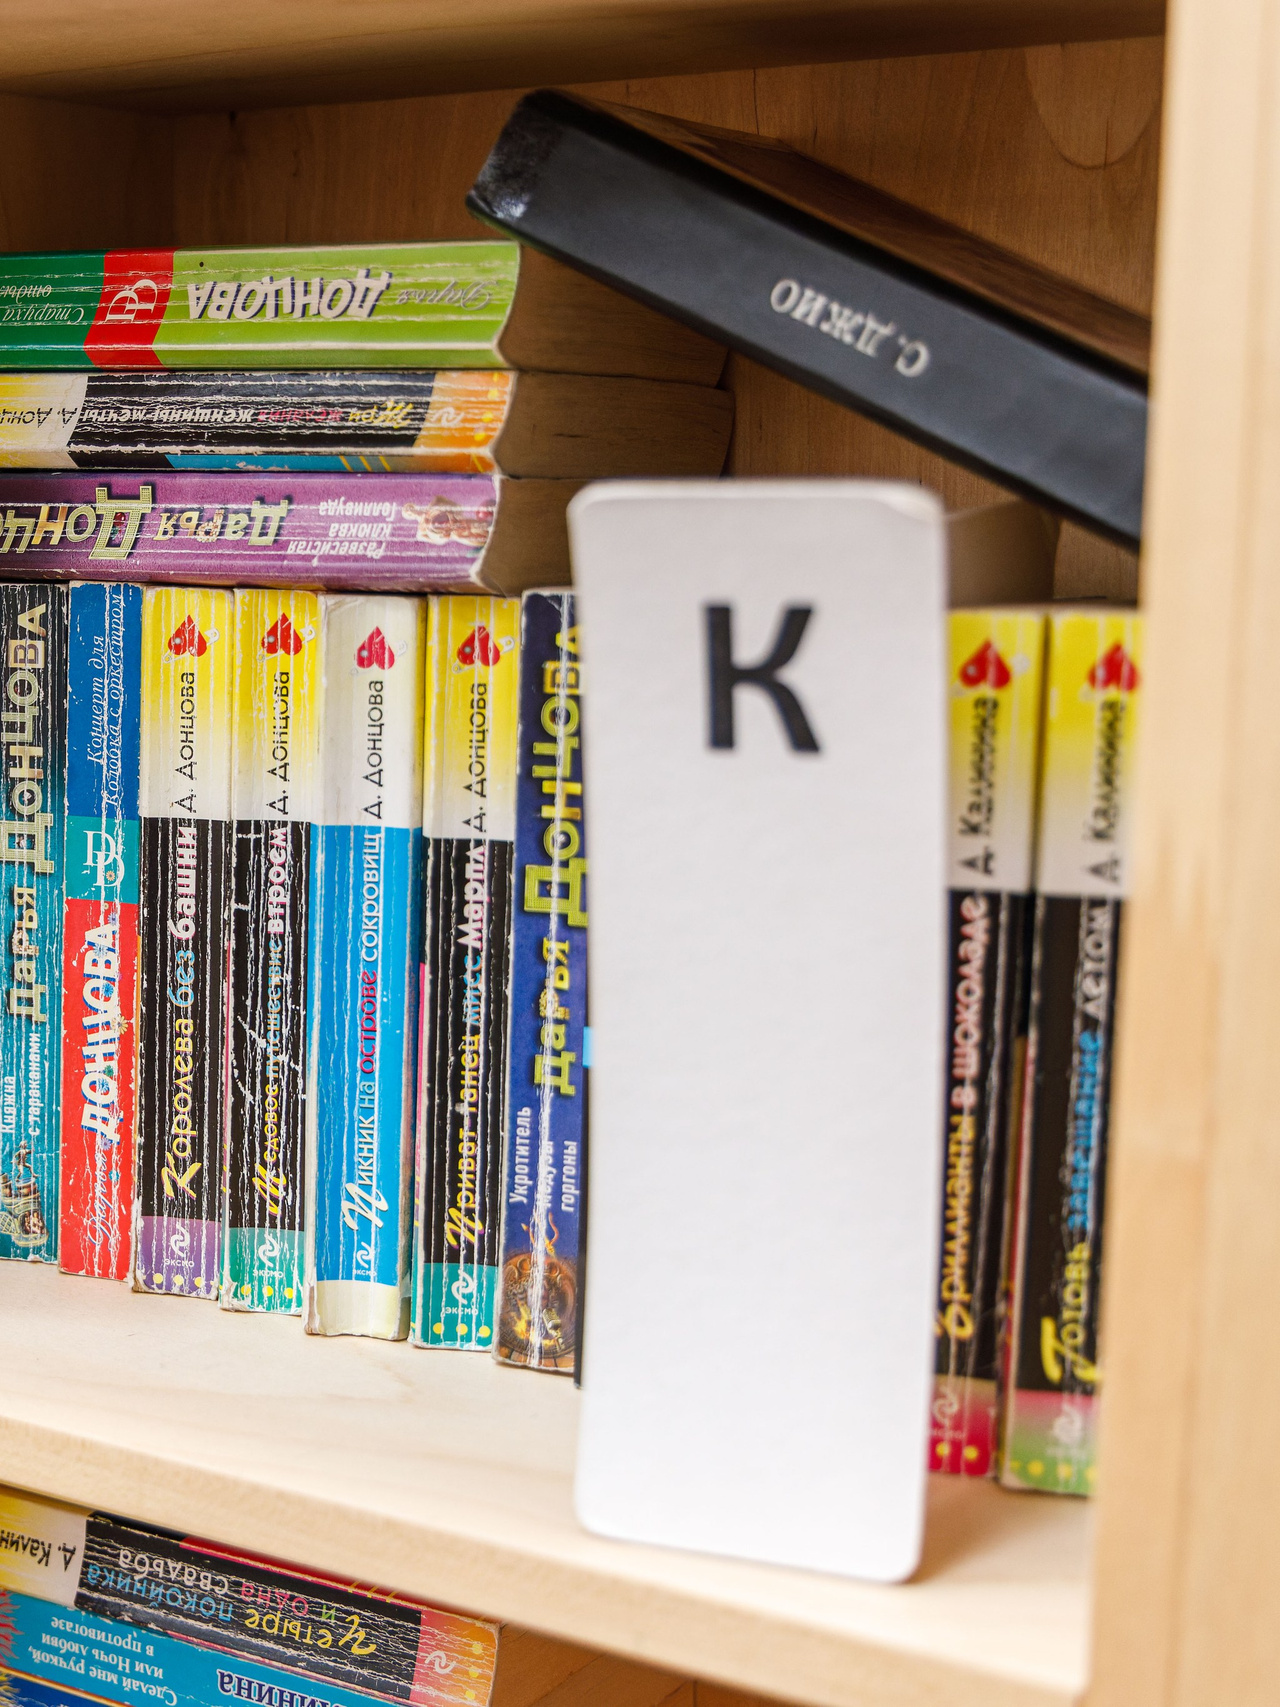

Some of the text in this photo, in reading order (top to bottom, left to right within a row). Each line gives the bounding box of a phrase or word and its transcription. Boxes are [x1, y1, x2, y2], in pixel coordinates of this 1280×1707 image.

[3, 305, 85, 325] Старуха
[188, 269, 393, 320] ДОНЦОВА
[770, 278, 894, 359] ДЖИО
[56, 404, 80, 427] Д.
[318, 497, 397, 521] Голливуда
[287, 541, 387, 559] Развесистая
[109, 593, 126, 701] оркестром
[86, 635, 105, 764] Концерт для
[110, 706, 121, 718] с
[174, 672, 197, 814] Д. Донцова
[266, 670, 290, 816] Д. Донцова
[361, 680, 384, 820] Д. Донцова
[462, 682, 488, 834] Д. Донцова
[266, 826, 290, 936] втроем
[457, 845, 487, 951] Марпл
[161, 825, 202, 1200] Королева без башни
[462, 954, 482, 1024] мисс
[81, 922, 124, 1145] ДОНЦОВА
[341, 831, 389, 1232] Пикник на острове сокровищ
[0, 1075, 17, 1135] Княжна
[29, 1032, 45, 1136] с тараканами
[952, 1086, 977, 1109] в
[509, 1106, 532, 1204] Укротитель
[561, 1140, 580, 1212] горгоны
[56, 1544, 77, 1574] Д.
[118, 1545, 336, 1622] и одна свадьба
[51, 1616, 155, 1657] в противогазе
[86, 1564, 377, 1655] Четыре покойника
[41, 1633, 164, 1680] или Ночь любви
[89, 1665, 119, 1682] мне
[122, 1677, 177, 1706] Сделай
[217, 1669, 350, 1707] инина
